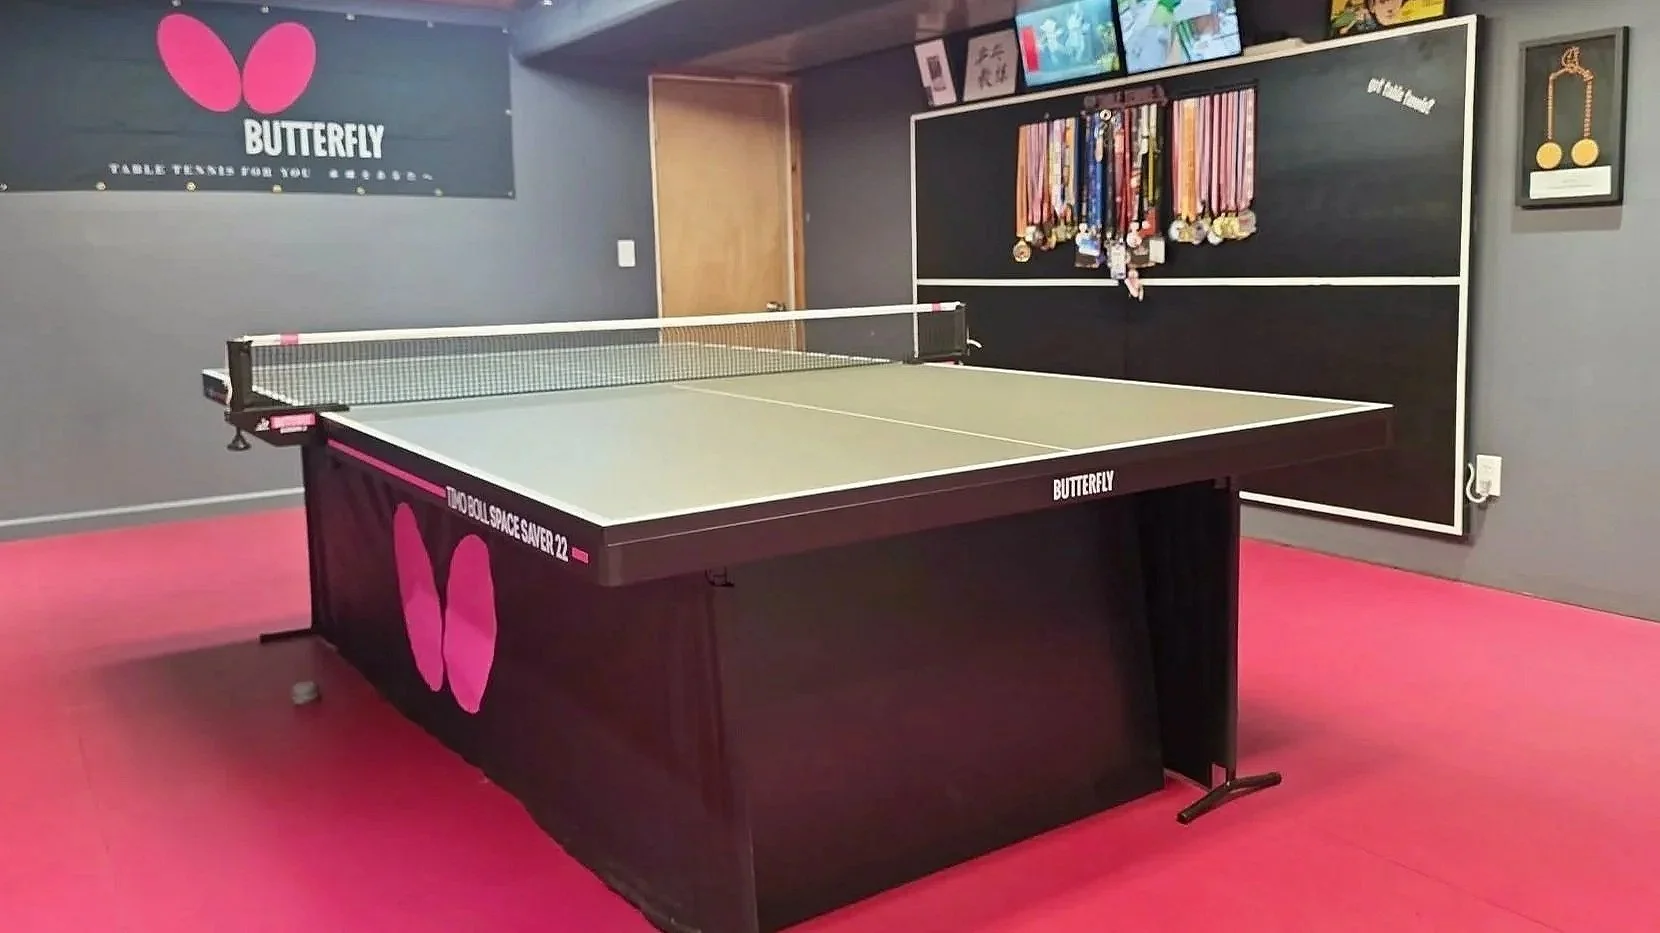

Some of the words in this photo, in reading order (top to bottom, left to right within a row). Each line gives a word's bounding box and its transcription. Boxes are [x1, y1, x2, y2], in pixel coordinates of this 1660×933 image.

[243, 118, 384, 159] BUTTERFLY
[108, 162, 166, 176] TABLE
[171, 164, 235, 177] TENNIS
[240, 166, 273, 178] FOR
[279, 166, 311, 179] YOU
[1053, 470, 1115, 501] BUTTERFLY
[446, 486, 468, 515] TIMO
[467, 495, 490, 526] BOLL
[489, 504, 521, 540] SPACE
[520, 518, 555, 557] SAVER
[554, 534, 569, 563] 22
